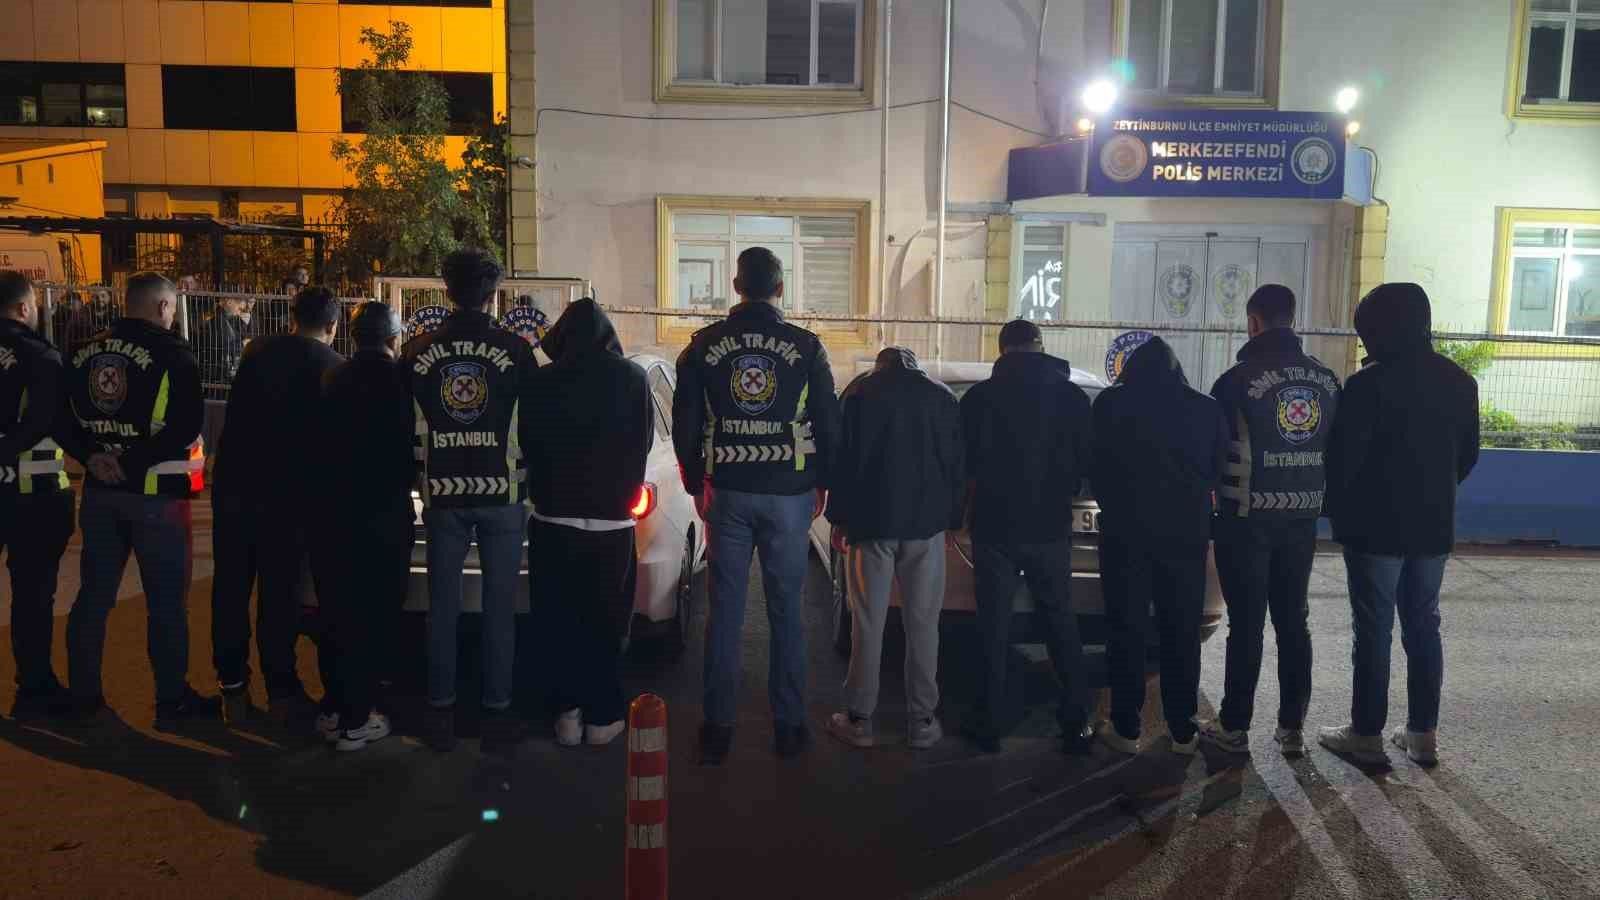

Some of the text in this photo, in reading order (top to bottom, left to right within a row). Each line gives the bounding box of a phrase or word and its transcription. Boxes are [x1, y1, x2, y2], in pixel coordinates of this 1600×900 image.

[1152, 140, 1287, 158] MERKEZEFENDİ
[1152, 162, 1283, 181] POLİS MERKEZİ
[413, 341, 515, 376] SİVİL TRAFİK
[742, 333, 803, 367] TRAFİK
[432, 431, 499, 448] İSTANBUL
